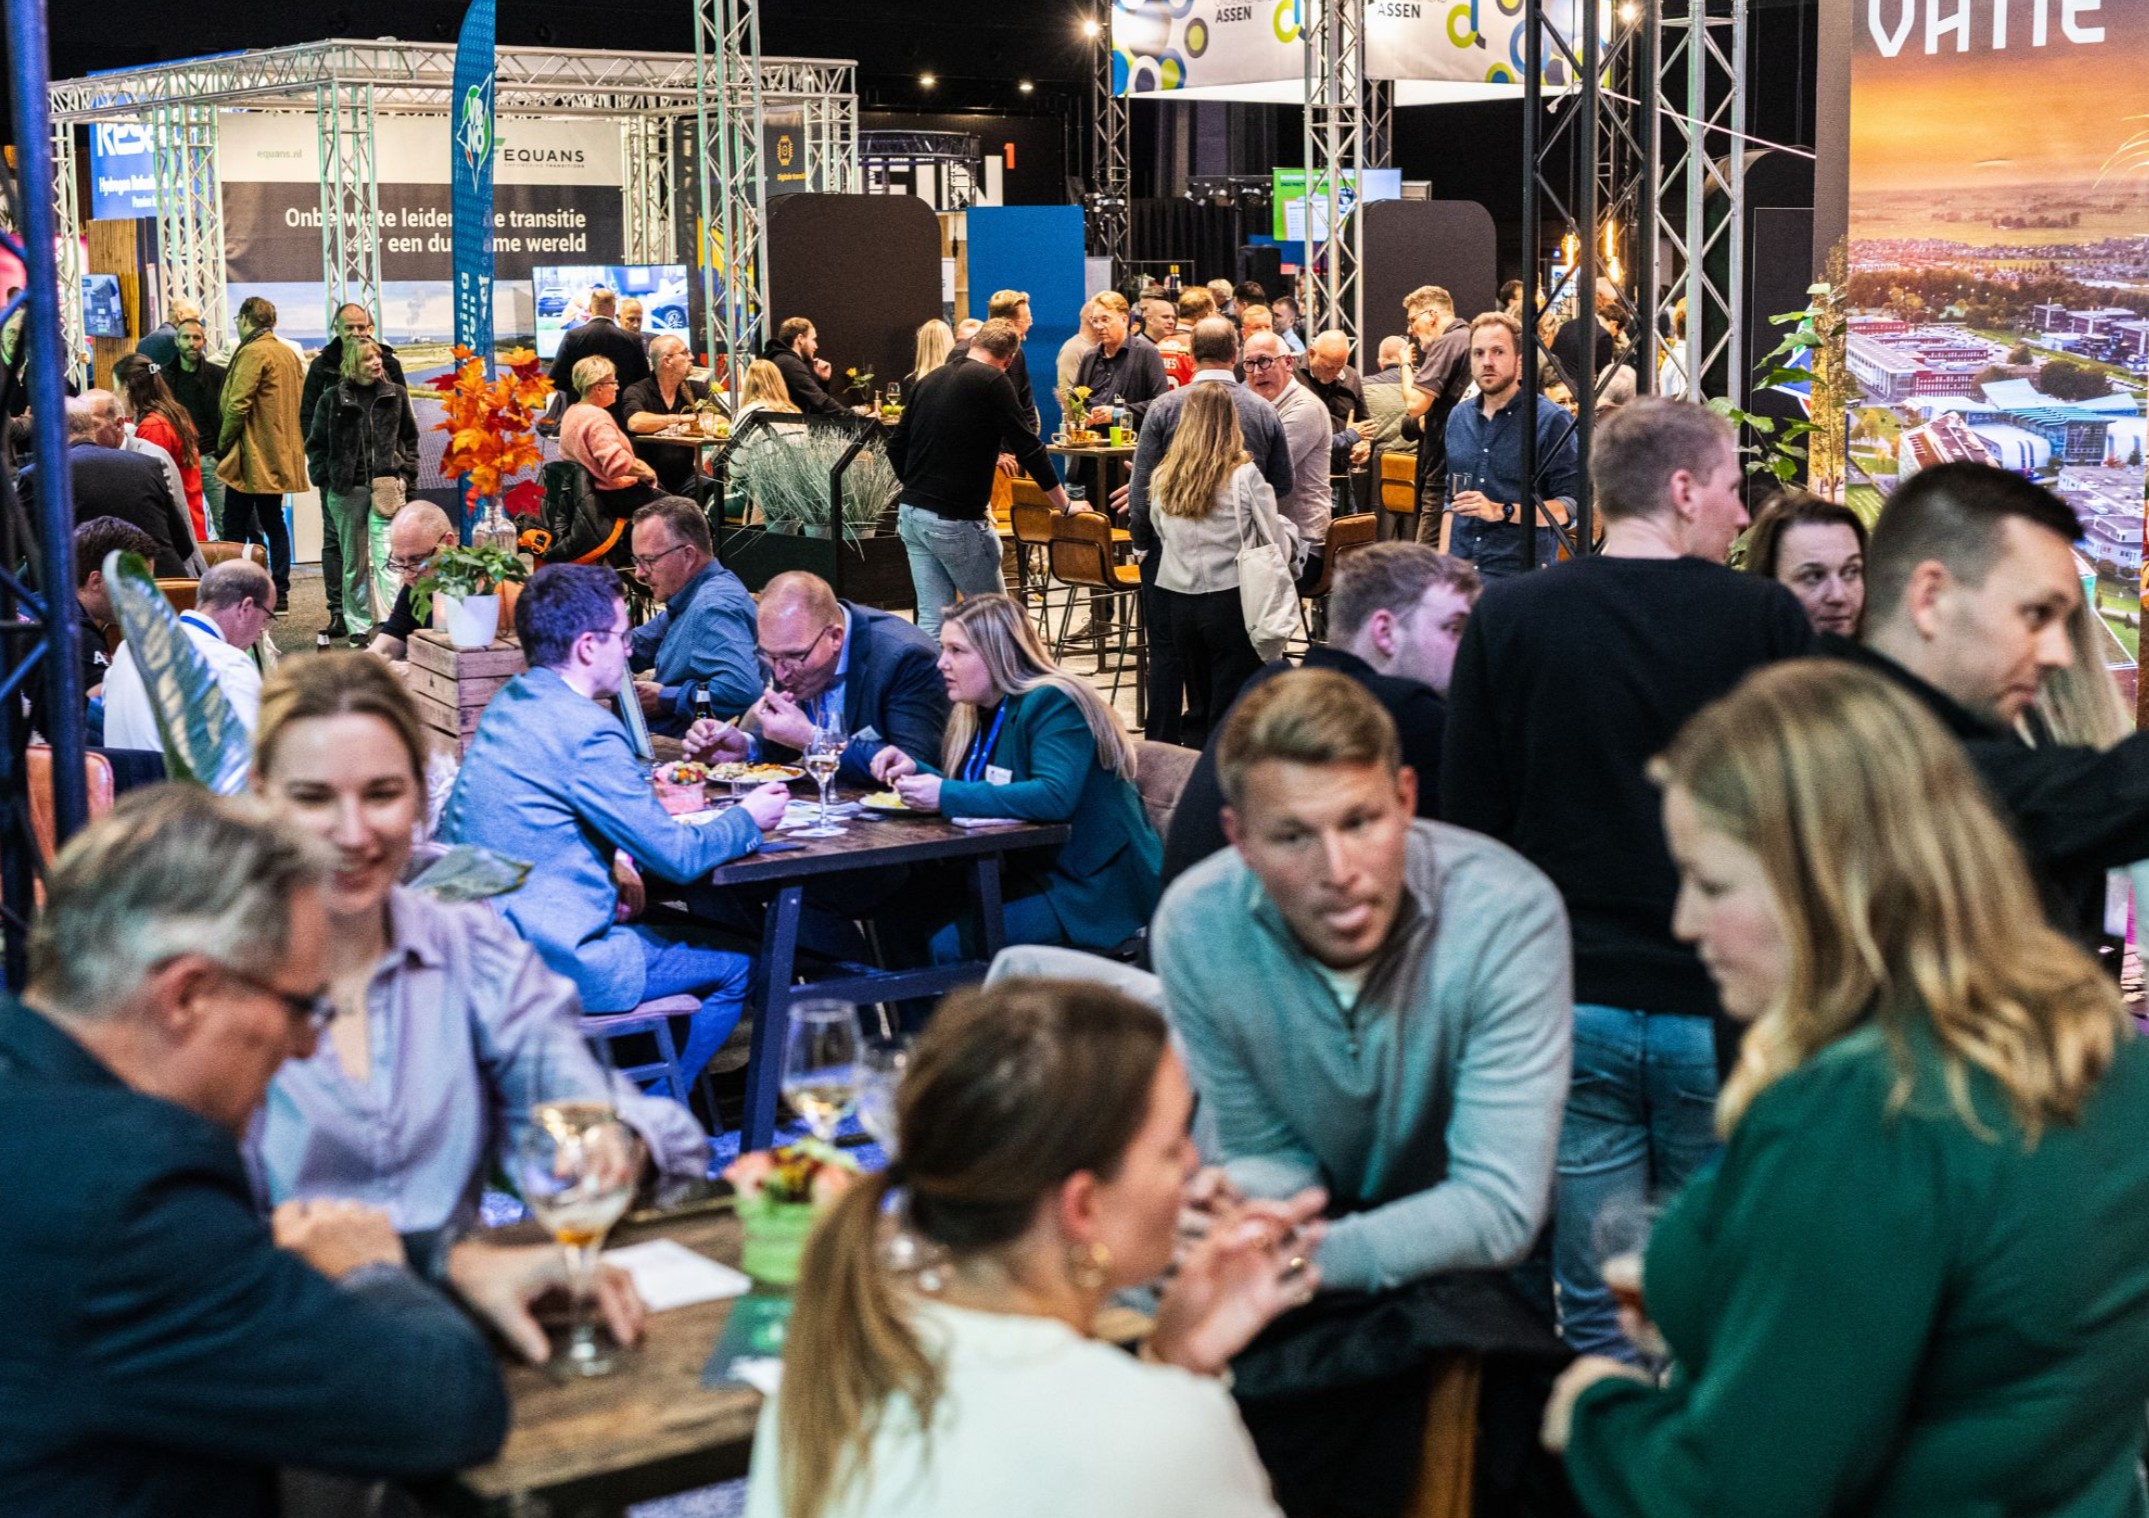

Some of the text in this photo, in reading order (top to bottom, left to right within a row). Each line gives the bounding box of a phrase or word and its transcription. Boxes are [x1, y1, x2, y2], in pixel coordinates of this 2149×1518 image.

[1215, 6, 1252, 23] ASSEN
[1377, 2, 1421, 19] ASSEN
[257, 148, 303, 160] equans.nl
[504, 149, 585, 163] EQUANS
[509, 208, 586, 227] transitie
[387, 236, 423, 252] een
[526, 232, 587, 252] wereld
